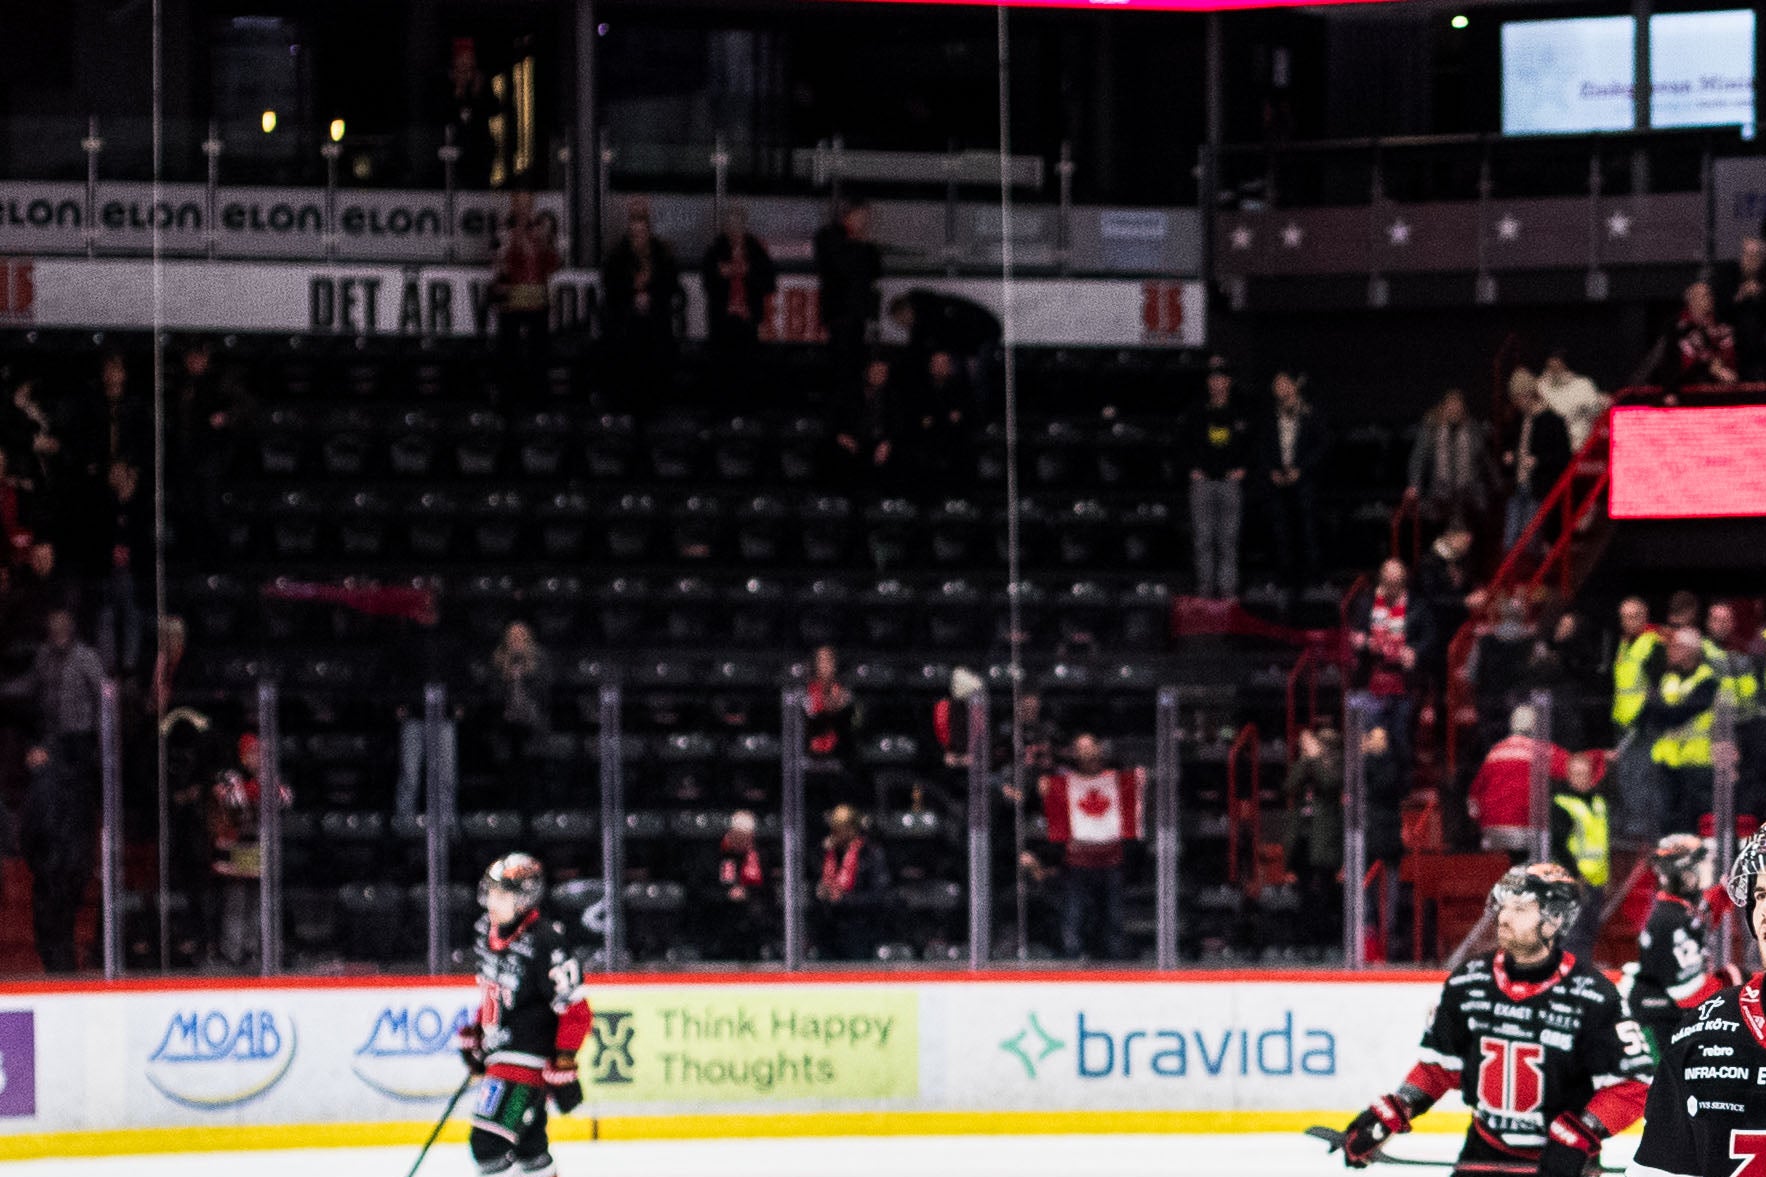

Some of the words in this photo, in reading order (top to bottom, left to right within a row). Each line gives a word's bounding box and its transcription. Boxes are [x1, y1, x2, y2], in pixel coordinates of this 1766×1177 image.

[0, 201, 81, 226] lon
[222, 204, 321, 230] elon
[342, 207, 440, 234] elon
[309, 277, 381, 328] DET
[150, 1008, 281, 1063] MOAB
[355, 1006, 474, 1057] MOA
[657, 1008, 757, 1040] Think
[770, 1008, 896, 1046] Happy
[1077, 1011, 1337, 1078] bravida
[657, 1051, 836, 1091] Thoughts
[1684, 1066, 1749, 1081] INFRA-CON
